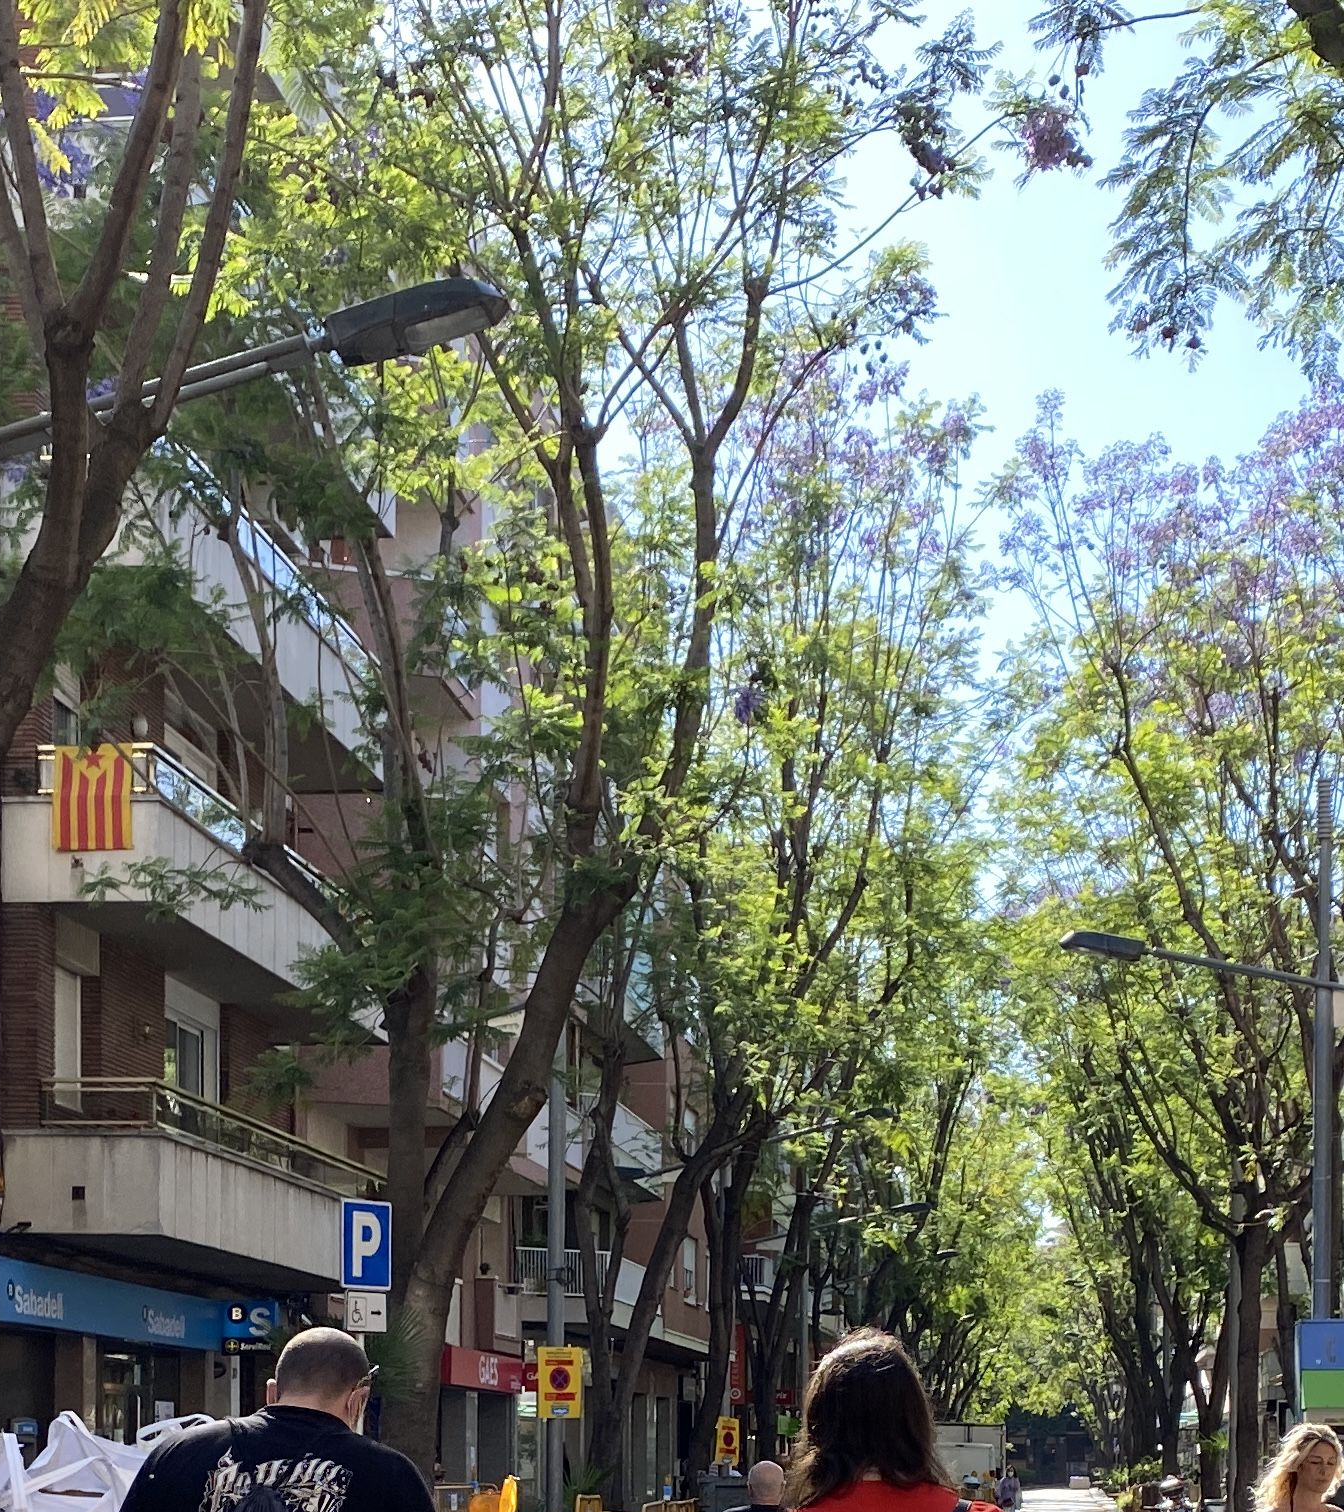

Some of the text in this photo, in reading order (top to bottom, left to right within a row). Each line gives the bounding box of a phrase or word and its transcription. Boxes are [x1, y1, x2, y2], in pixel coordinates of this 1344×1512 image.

[352, 1210, 381, 1278] P
[14, 1284, 64, 1321] Sabadell
[231, 1307, 273, 1337] B S
[478, 1355, 499, 1386] GAES
